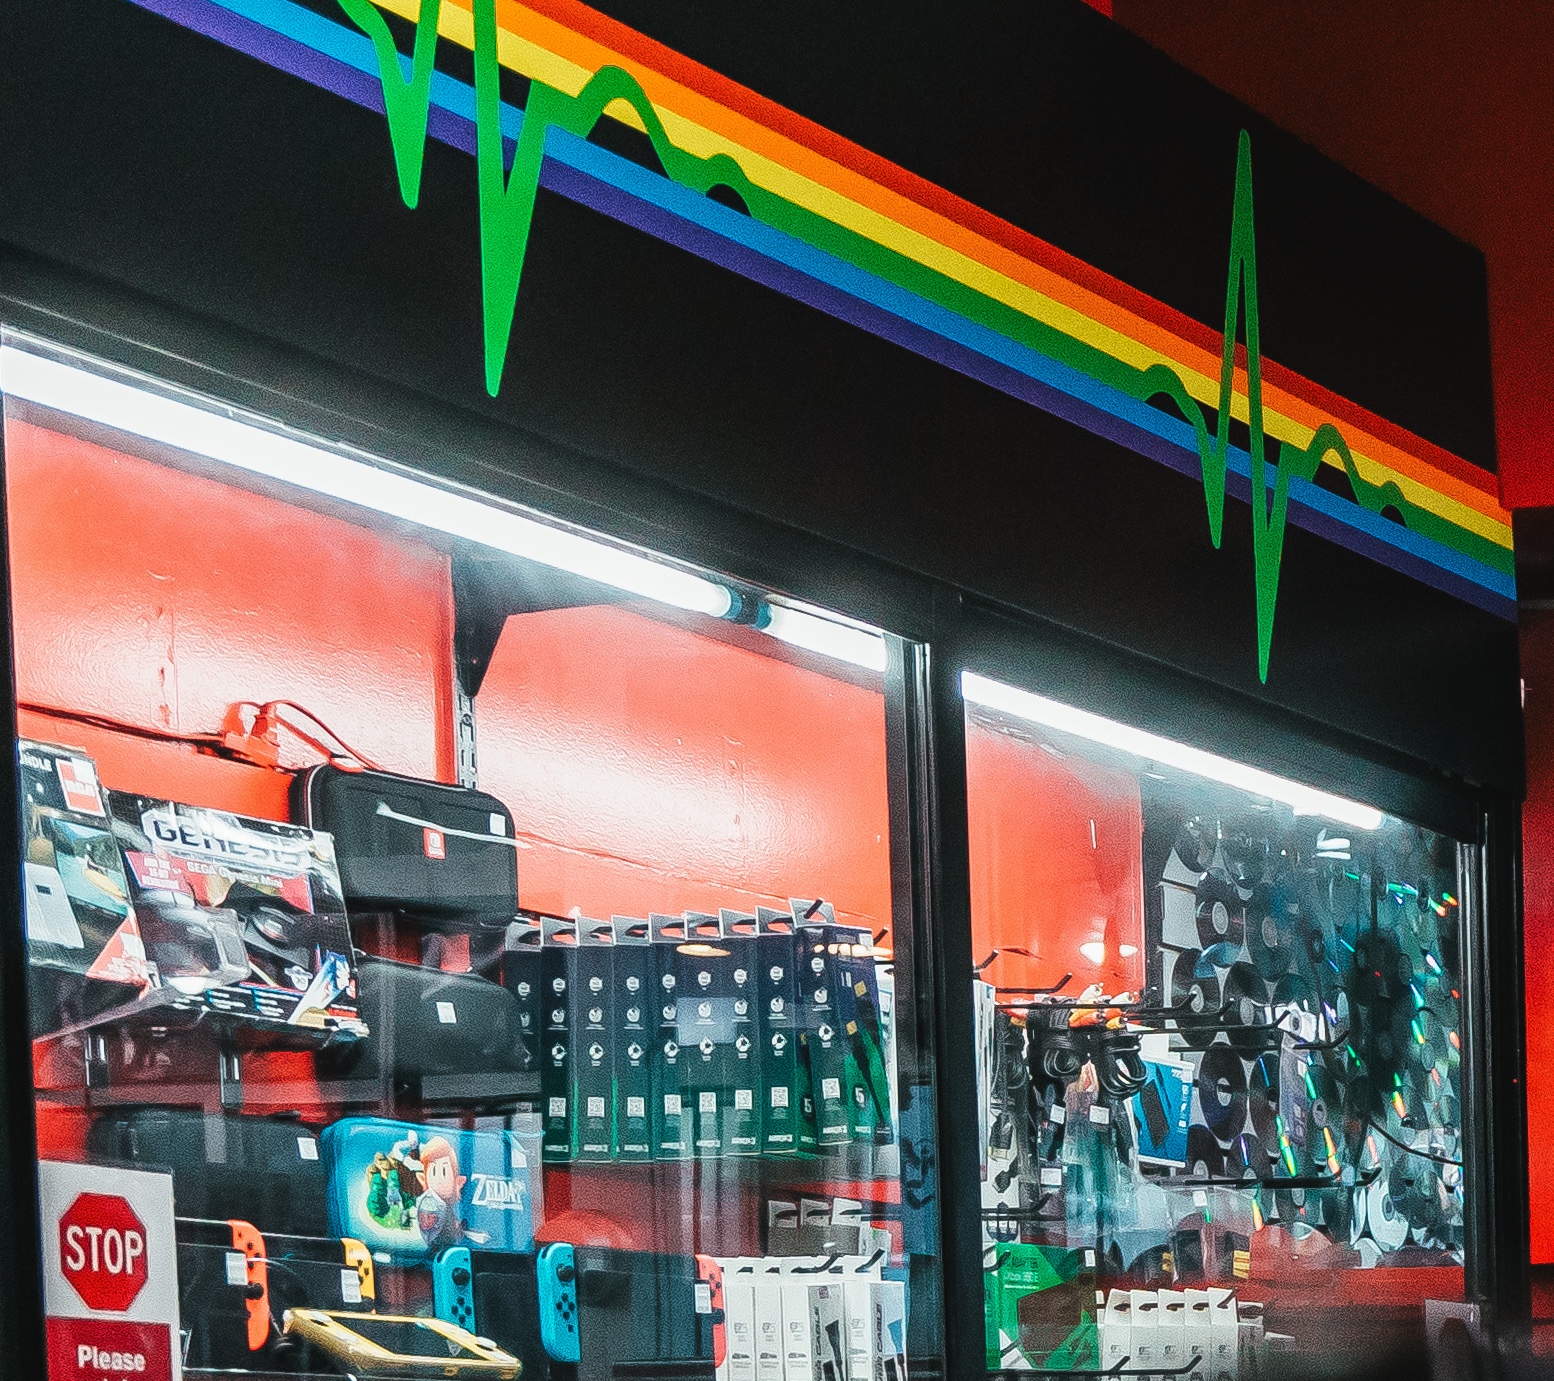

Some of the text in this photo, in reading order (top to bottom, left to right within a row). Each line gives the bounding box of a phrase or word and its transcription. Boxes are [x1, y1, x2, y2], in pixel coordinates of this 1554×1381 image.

[186, 859, 216, 876] SEGA
[65, 1225, 145, 1276] STOP
[77, 1344, 147, 1373] Please
